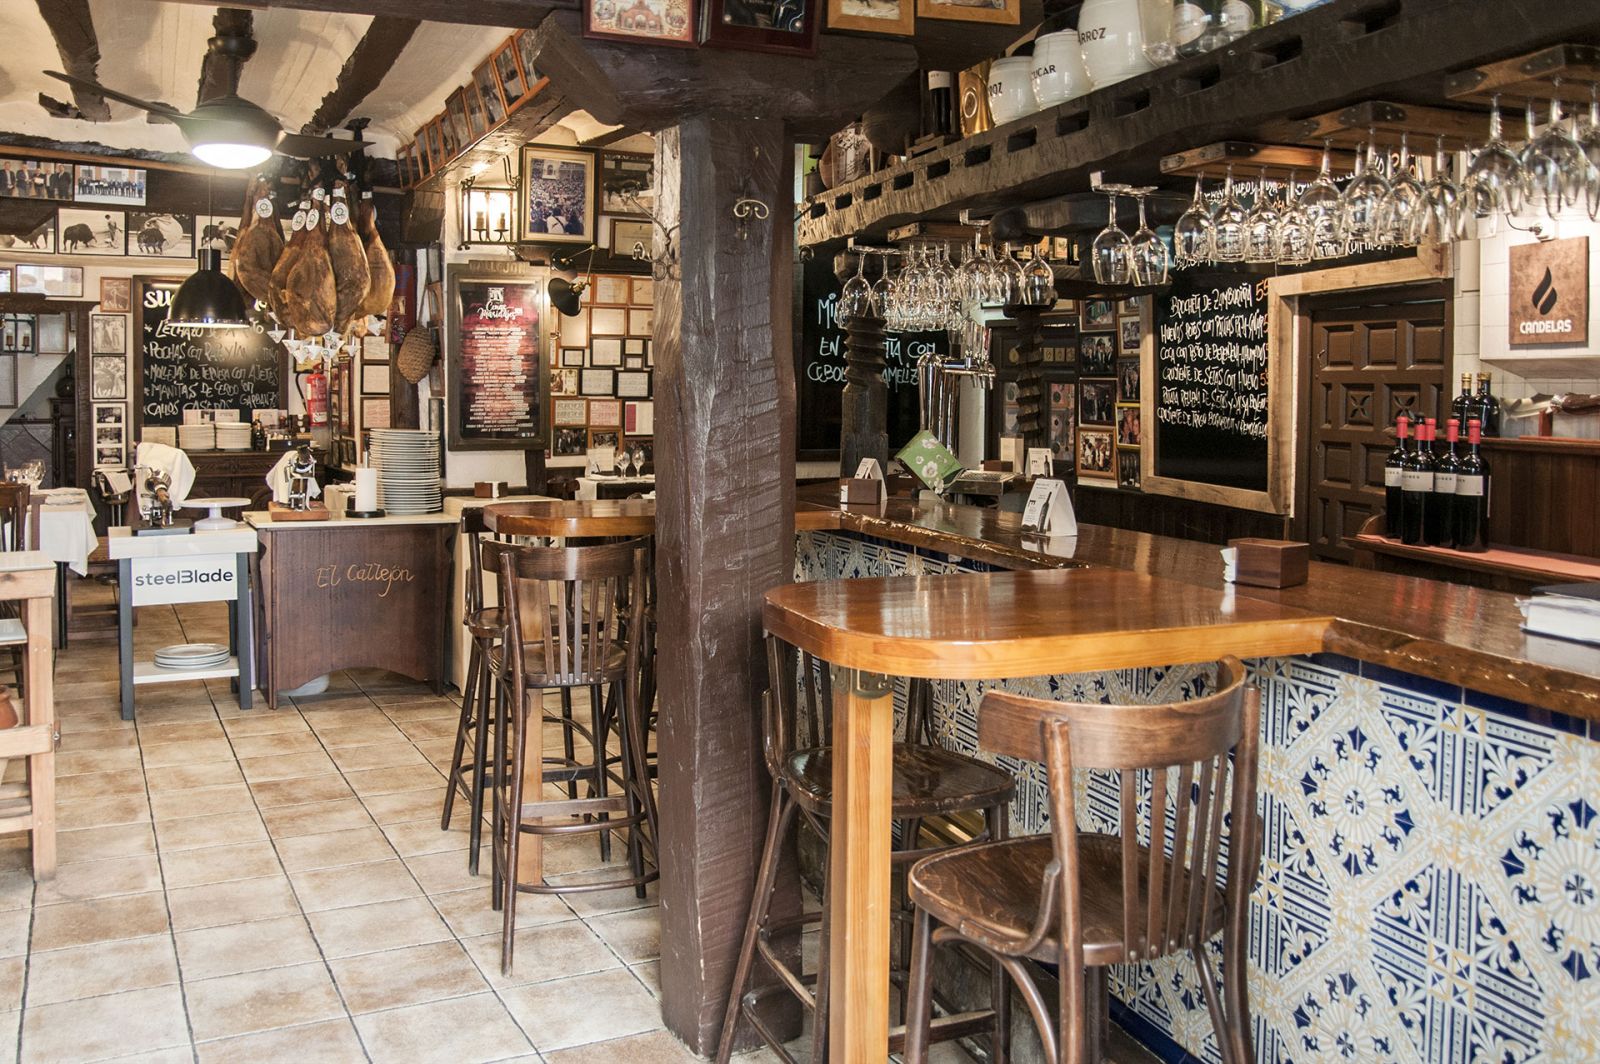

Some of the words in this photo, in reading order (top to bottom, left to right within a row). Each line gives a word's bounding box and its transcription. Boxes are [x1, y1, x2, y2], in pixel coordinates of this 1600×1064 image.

[1519, 319, 1573, 334] CANDELAS
[819, 335, 841, 357] EN
[147, 400, 179, 419] CALLOS
[135, 568, 234, 586] steelBlade
[316, 565, 341, 588] El
[347, 562, 415, 597] Callejón
